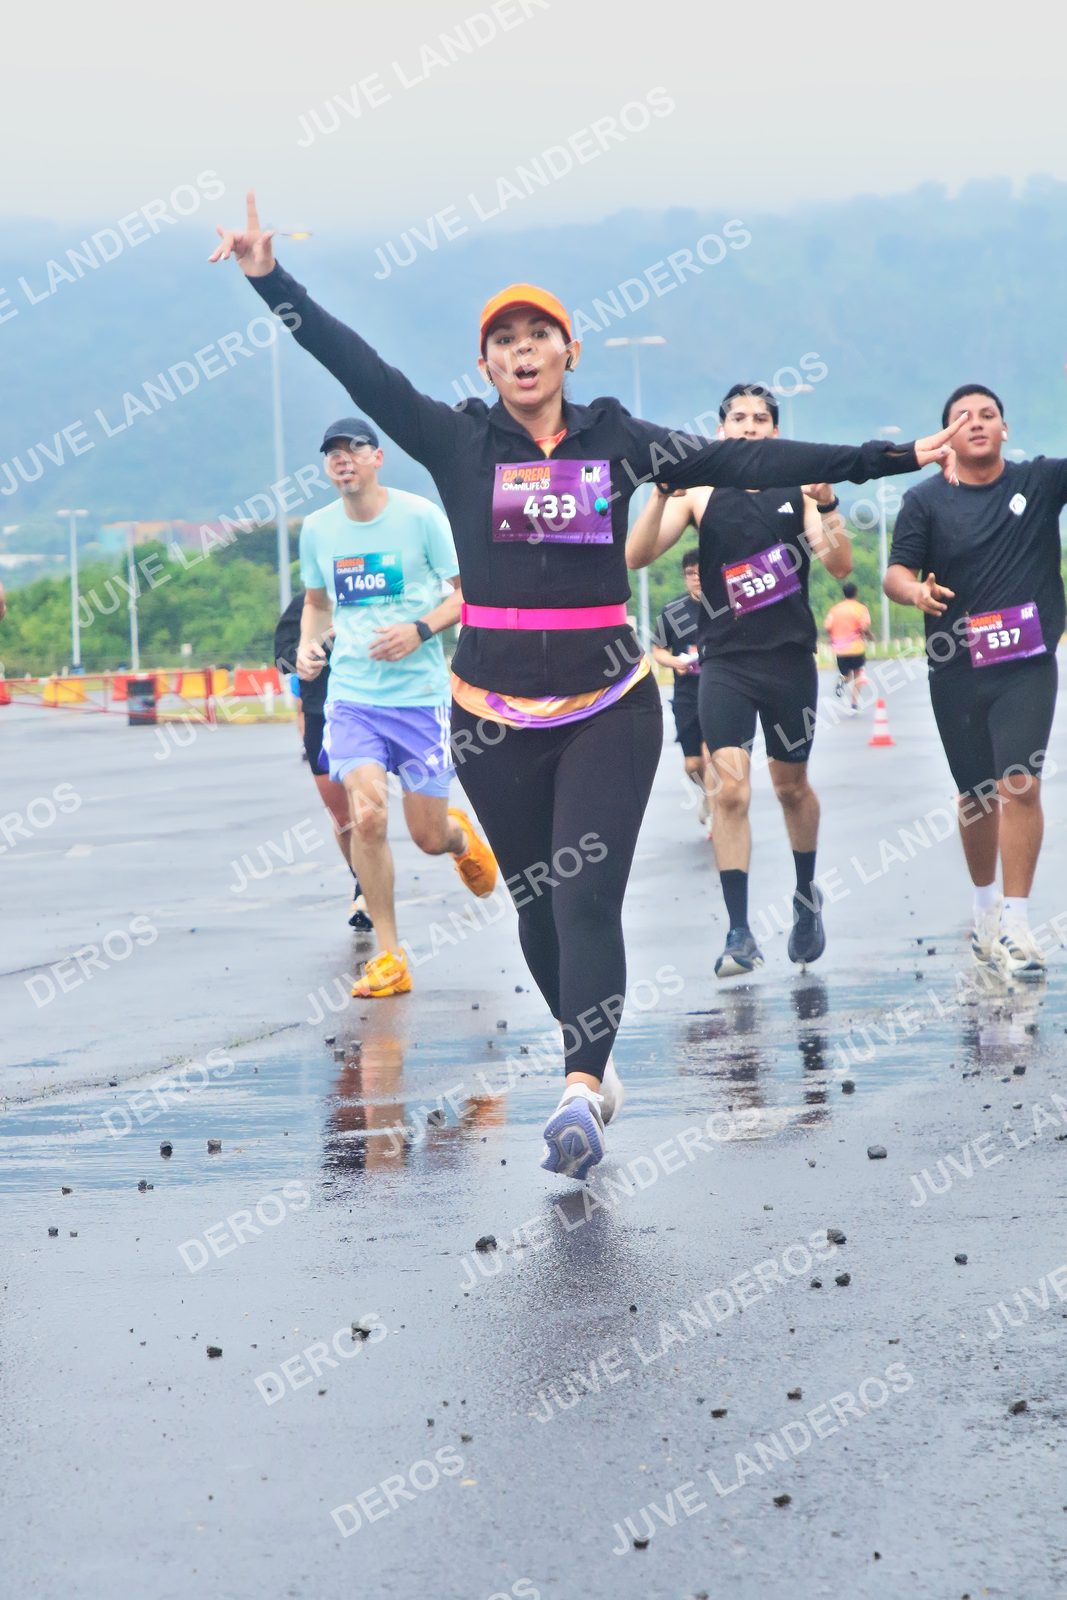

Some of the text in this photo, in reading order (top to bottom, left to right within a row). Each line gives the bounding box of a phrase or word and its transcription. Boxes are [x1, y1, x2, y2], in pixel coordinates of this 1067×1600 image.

[523, 494, 577, 518] 433
[344, 573, 386, 591] 1406
[742, 573, 776, 598] 539
[987, 628, 1020, 649] 537
